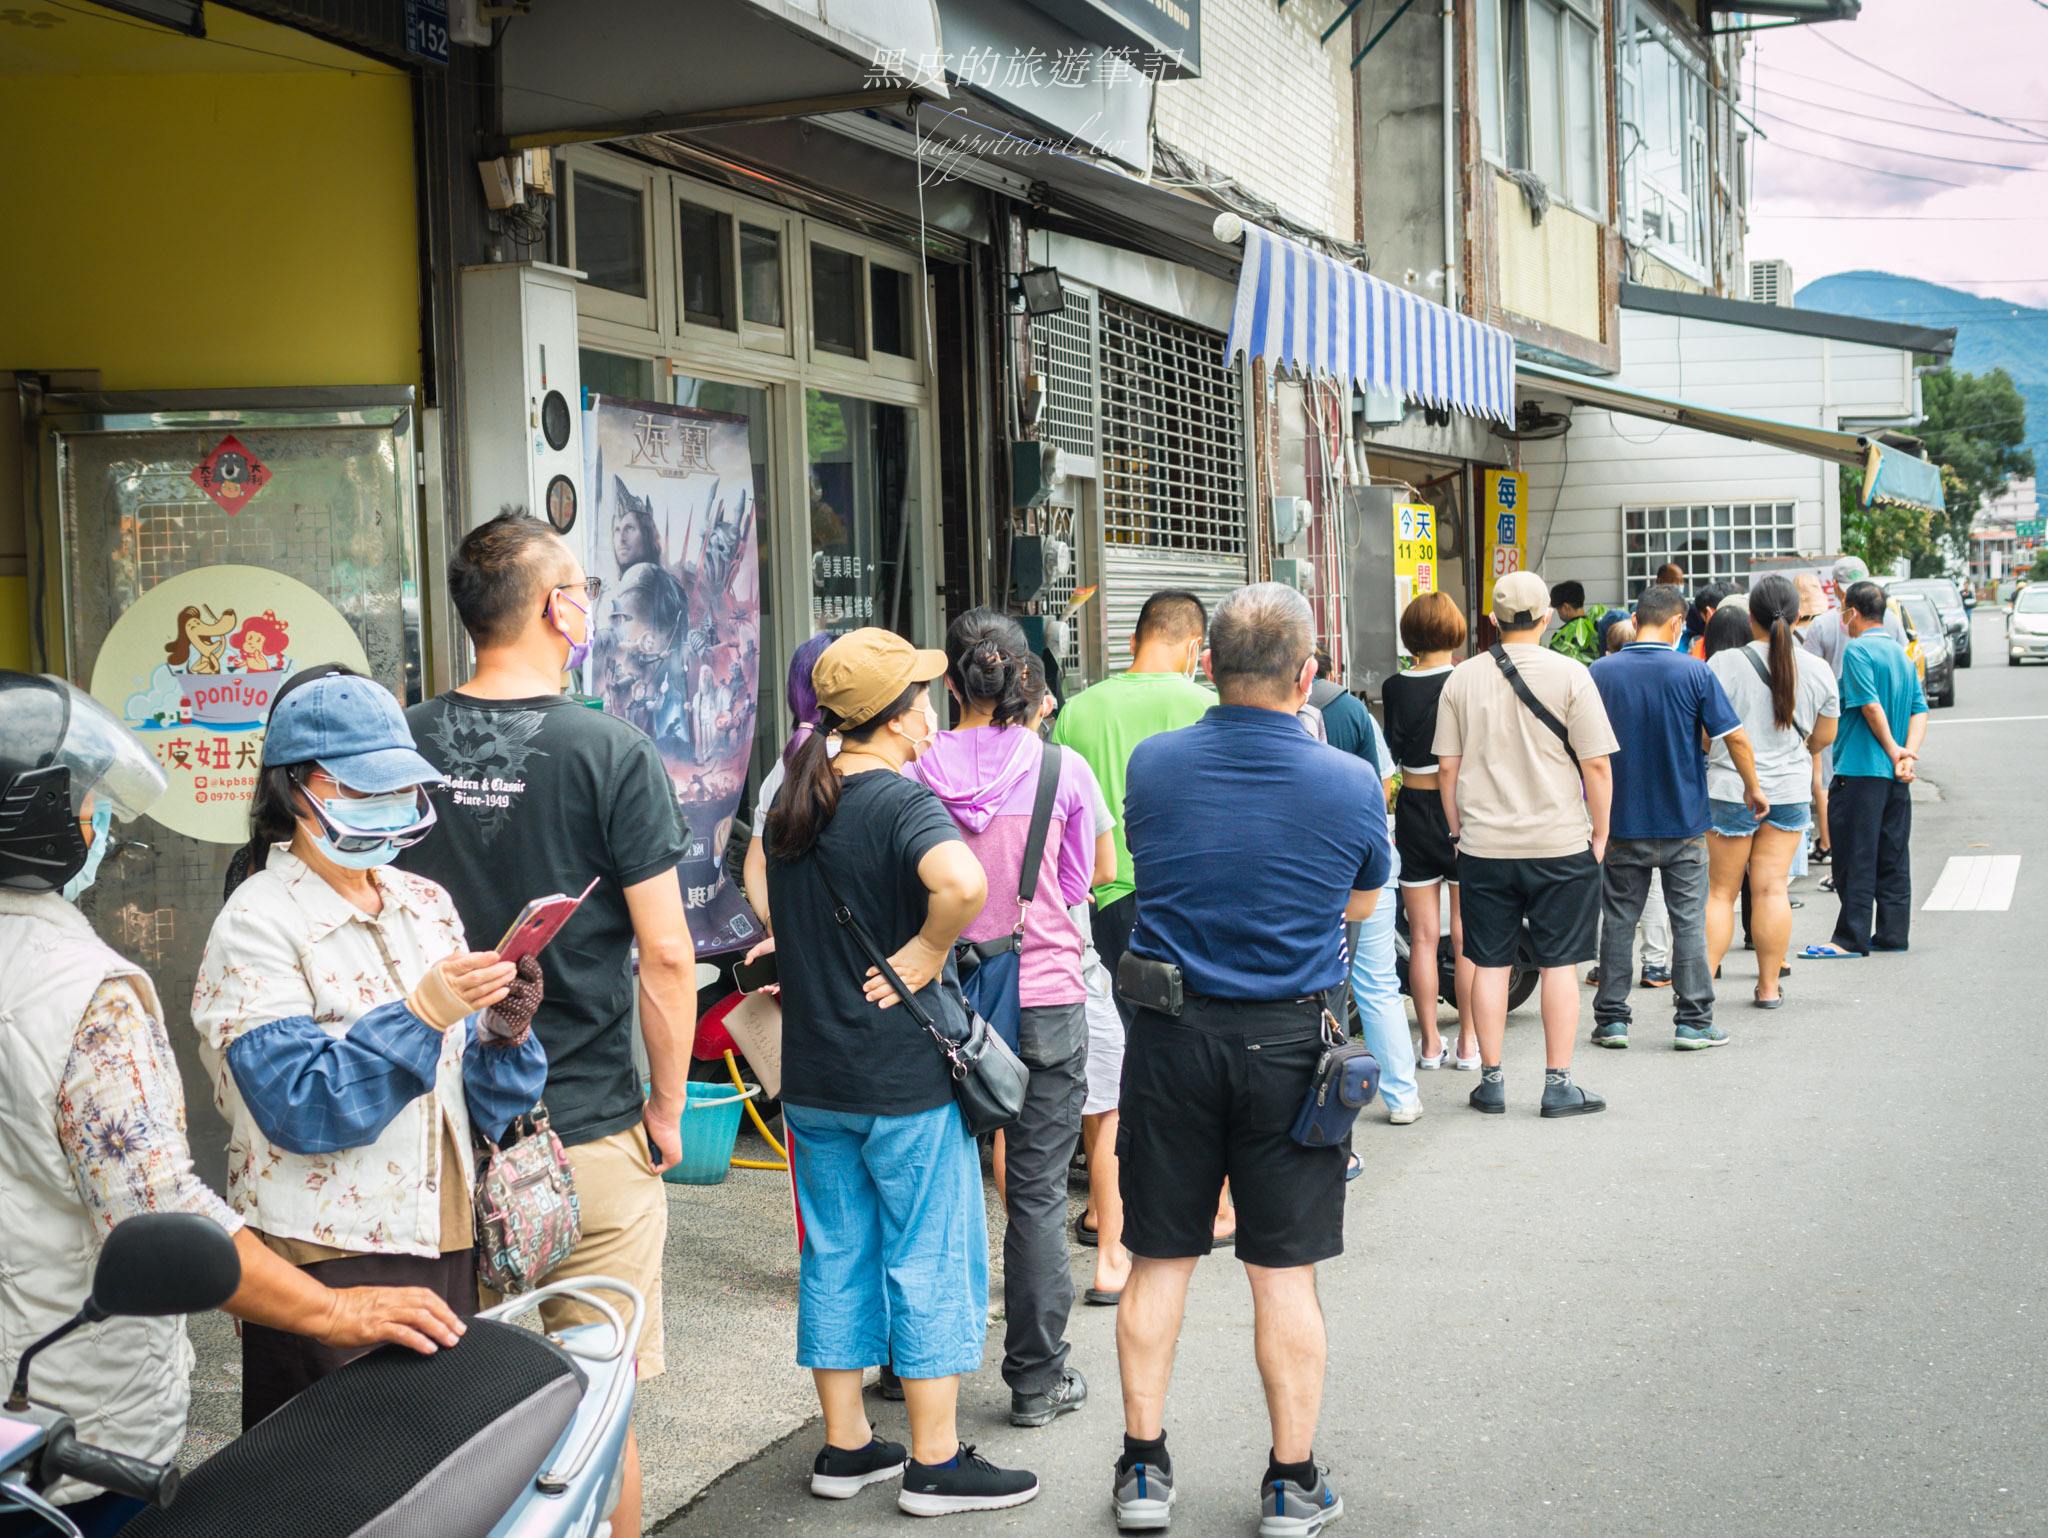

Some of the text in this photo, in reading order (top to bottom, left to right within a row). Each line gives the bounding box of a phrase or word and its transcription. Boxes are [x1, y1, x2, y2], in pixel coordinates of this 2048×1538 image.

[417, 20, 448, 56] 152
[1401, 509, 1432, 539] 今天
[1497, 476, 1517, 545] 每個
[1495, 548, 1518, 576] 38
[194, 679, 268, 710] poniyo
[157, 736, 263, 770] 波妞犬
[481, 778, 490, 791] &
[491, 777, 526, 793] Classic
